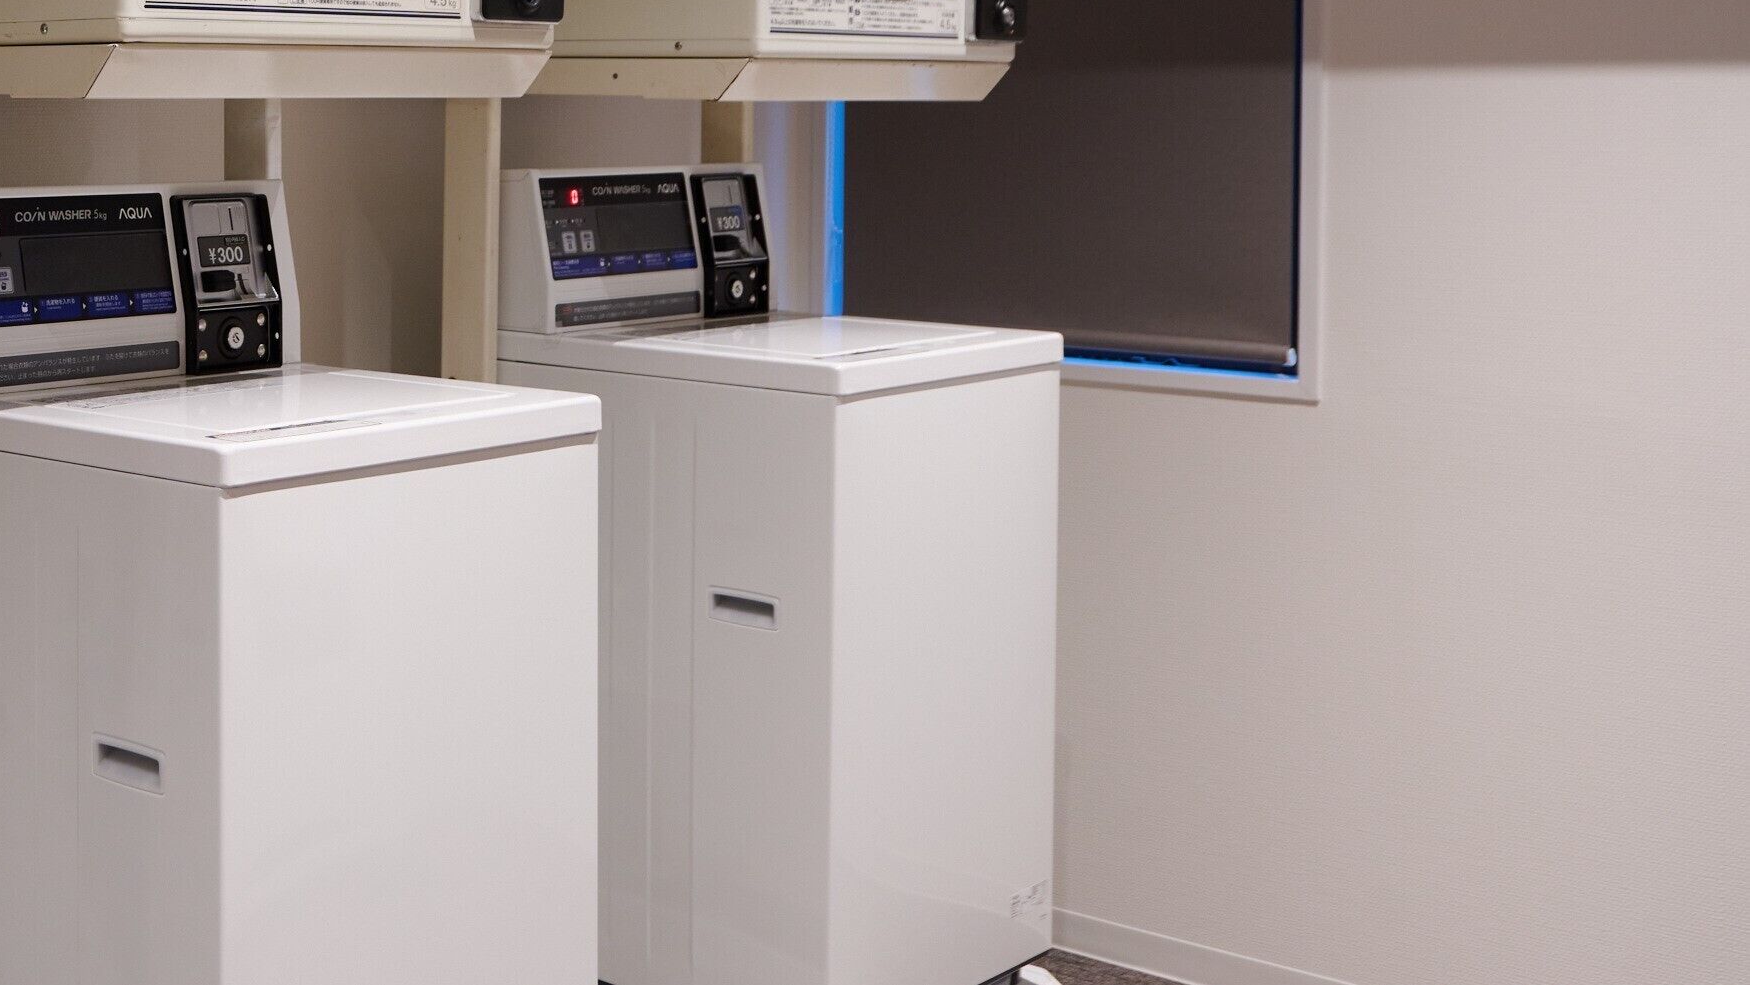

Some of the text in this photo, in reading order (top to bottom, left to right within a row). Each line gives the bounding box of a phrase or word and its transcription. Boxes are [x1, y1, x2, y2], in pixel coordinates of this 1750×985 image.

[613, 184, 641, 195] WASHER
[657, 183, 680, 193] AQUA
[570, 189, 579, 205] 0
[48, 209, 91, 221] WASHER
[119, 206, 153, 220] AQUA
[717, 215, 741, 230] ¥300
[208, 245, 244, 264] ¥300
